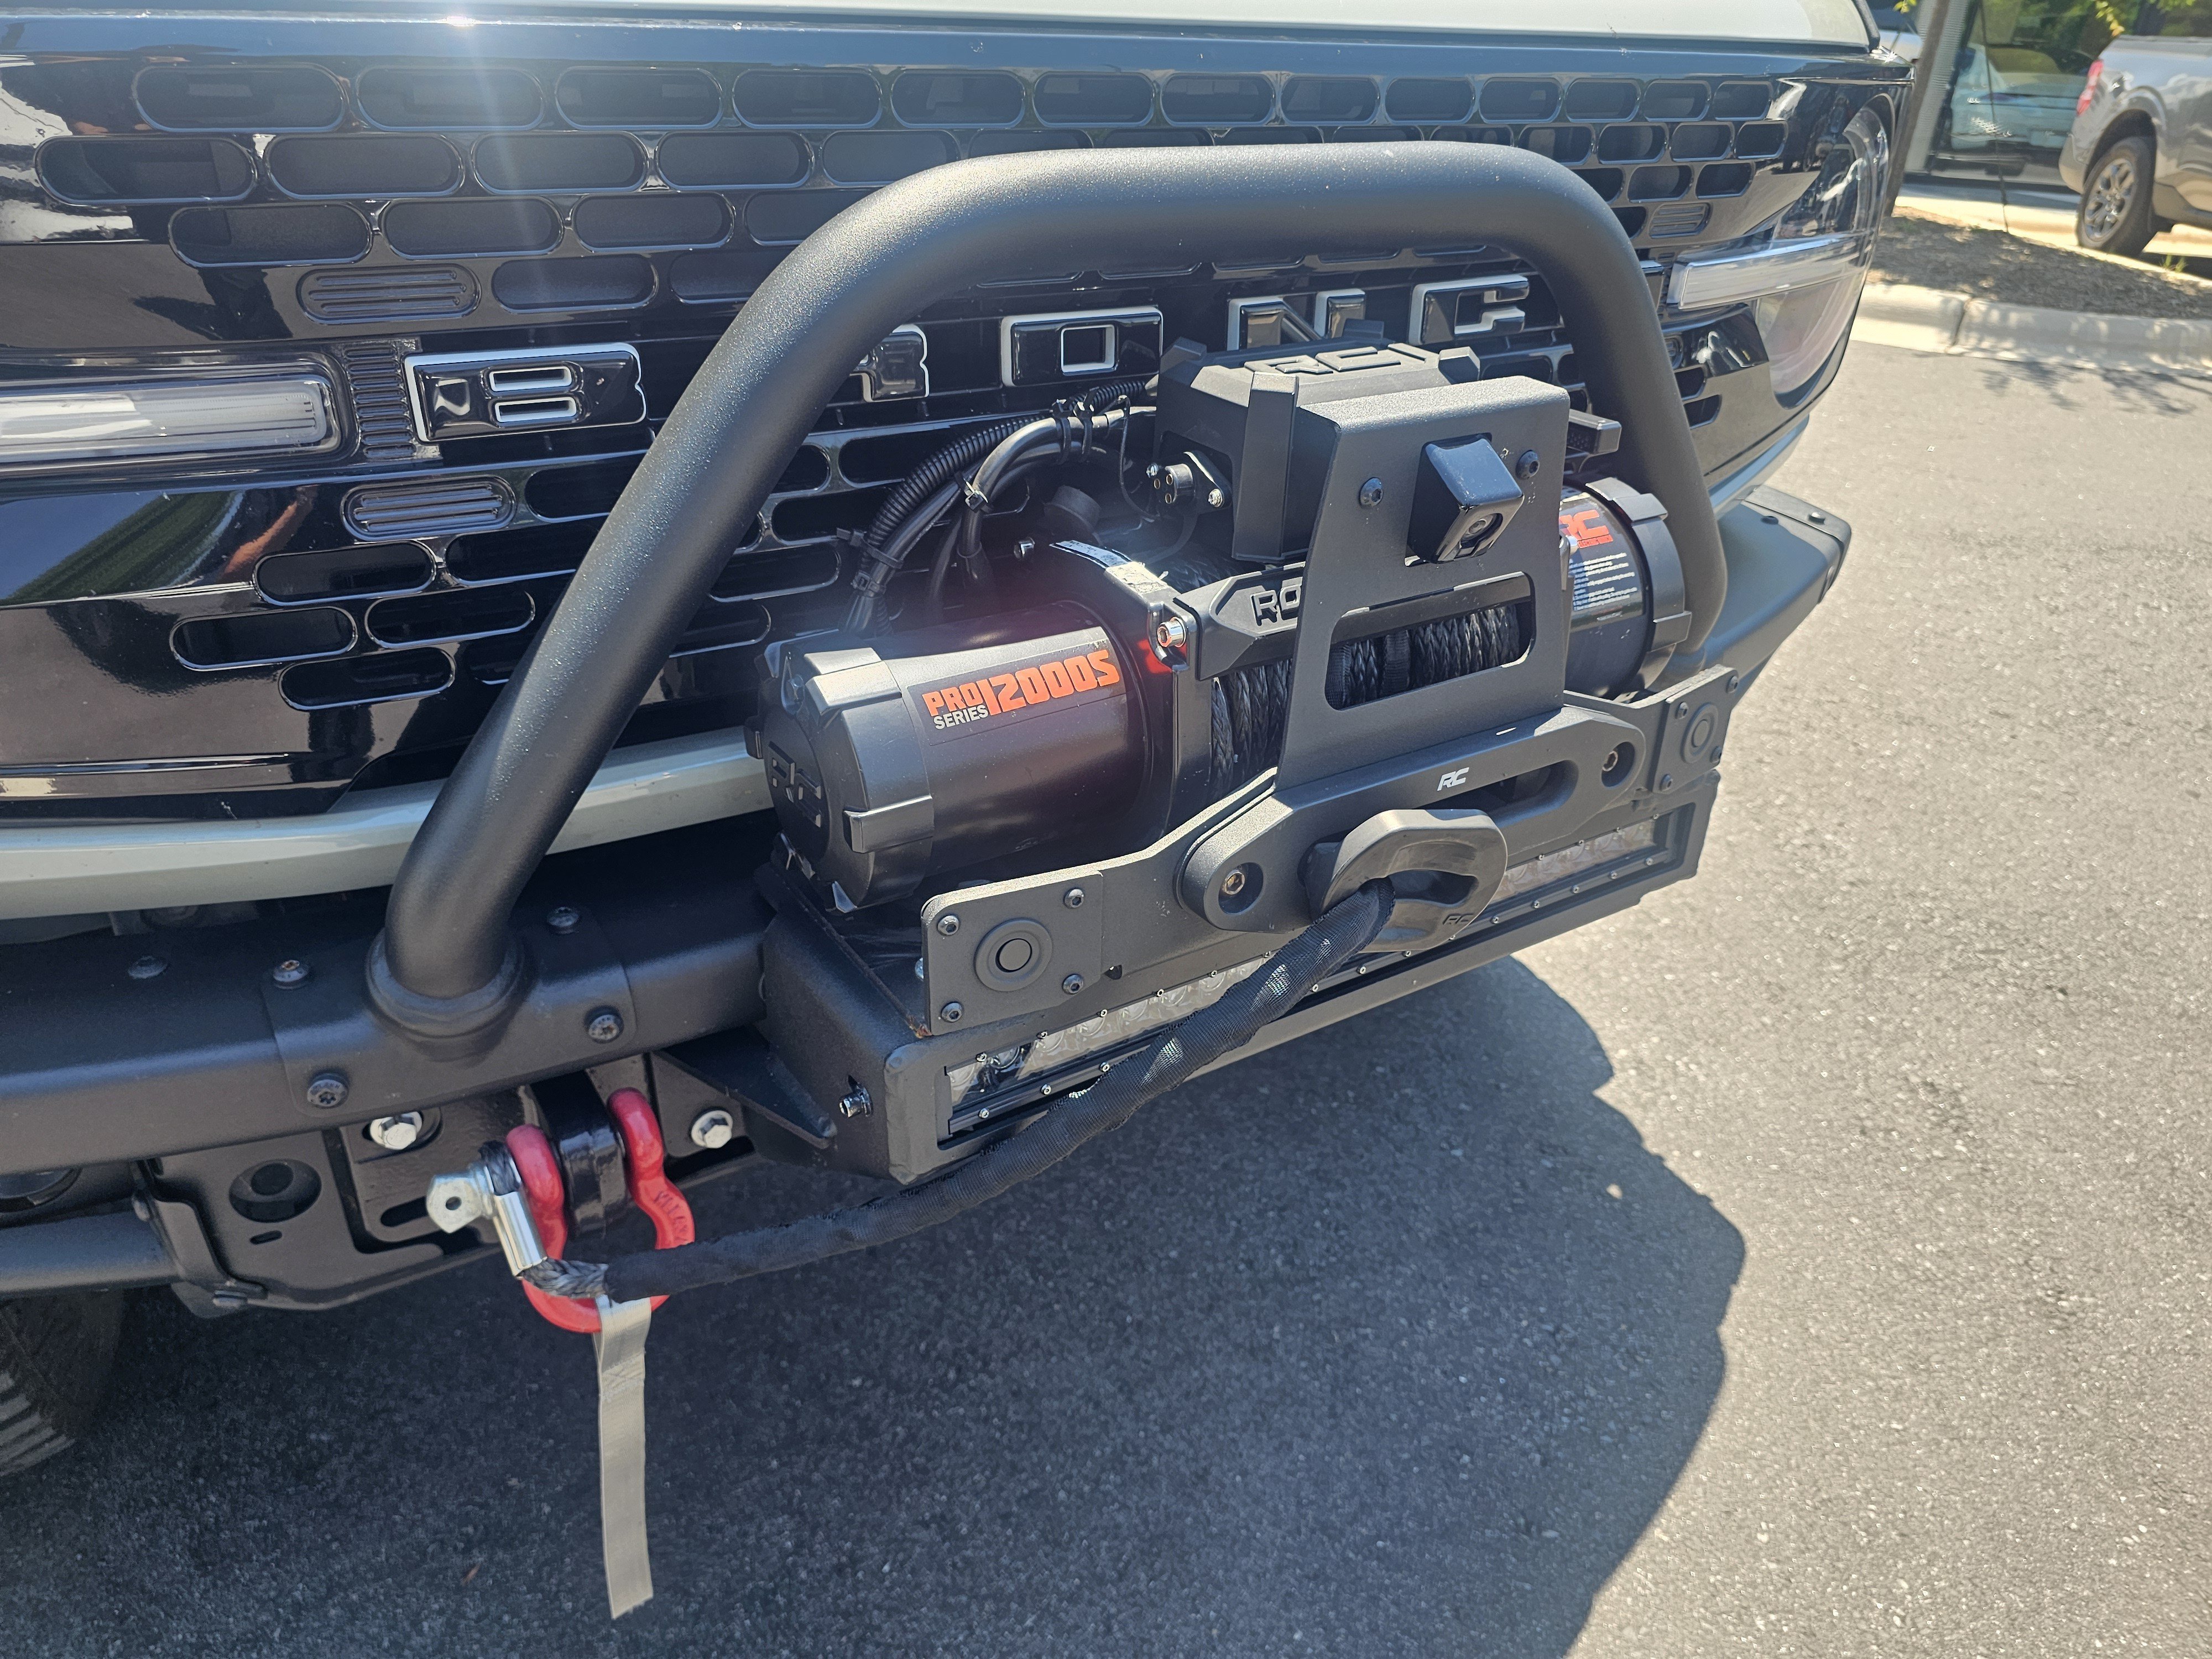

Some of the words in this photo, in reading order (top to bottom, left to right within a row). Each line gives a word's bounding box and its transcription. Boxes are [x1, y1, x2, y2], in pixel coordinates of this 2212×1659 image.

[922, 681, 983, 717] PRO
[976, 649, 1120, 716] 12000S
[933, 705, 989, 730] SERIES
[768, 740, 821, 828] RC
[1437, 767, 1470, 791] RC
[1442, 913, 1475, 926] RC
